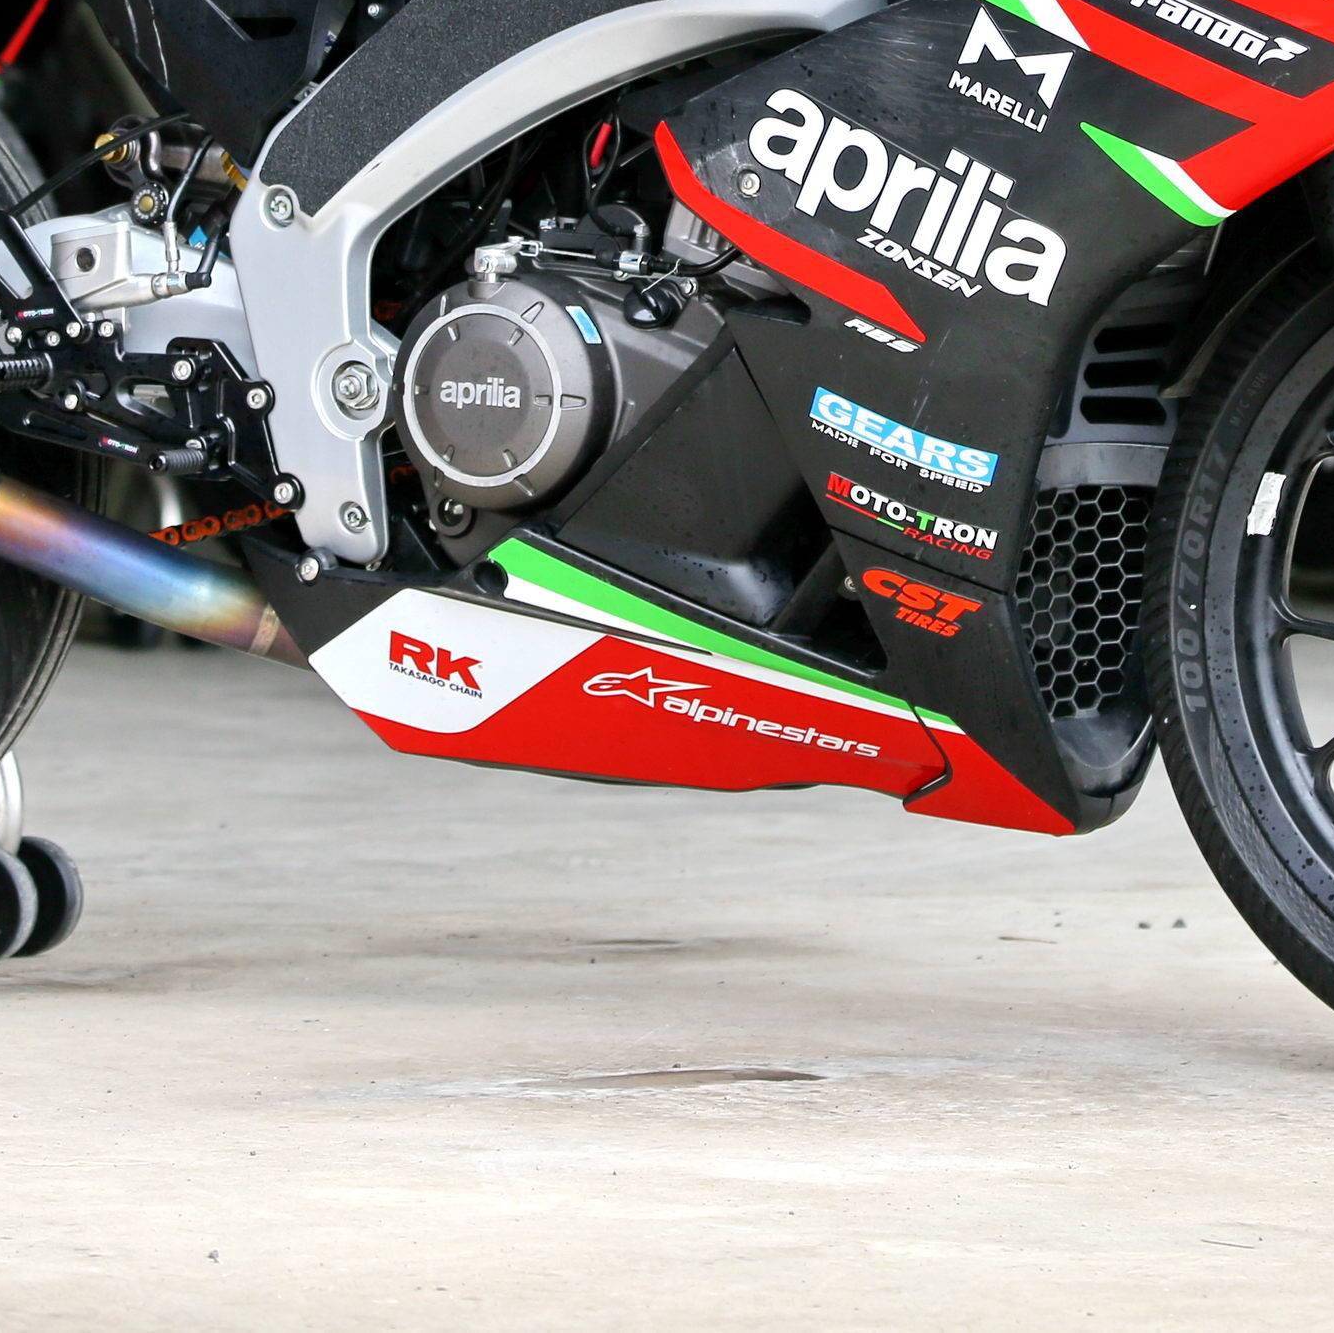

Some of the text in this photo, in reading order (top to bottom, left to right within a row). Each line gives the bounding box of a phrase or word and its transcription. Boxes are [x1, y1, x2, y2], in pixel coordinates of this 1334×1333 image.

[948, 70, 1048, 133] MARELLI
[748, 88, 1068, 307] aprilia
[855, 227, 983, 299] ZONSEN
[843, 316, 920, 353] ABS
[440, 377, 521, 409] aprilia
[811, 419, 984, 494] MADE FOR SPEED
[818, 393, 991, 478] GEARS
[827, 473, 998, 550] MOTO-TRON
[903, 527, 995, 561] RACING
[861, 569, 984, 622] CST
[894, 606, 962, 638] TIRES
[389, 630, 482, 691] RK
[389, 662, 483, 699] TAKASAGO CHAIN
[663, 695, 881, 758] alpinestars
